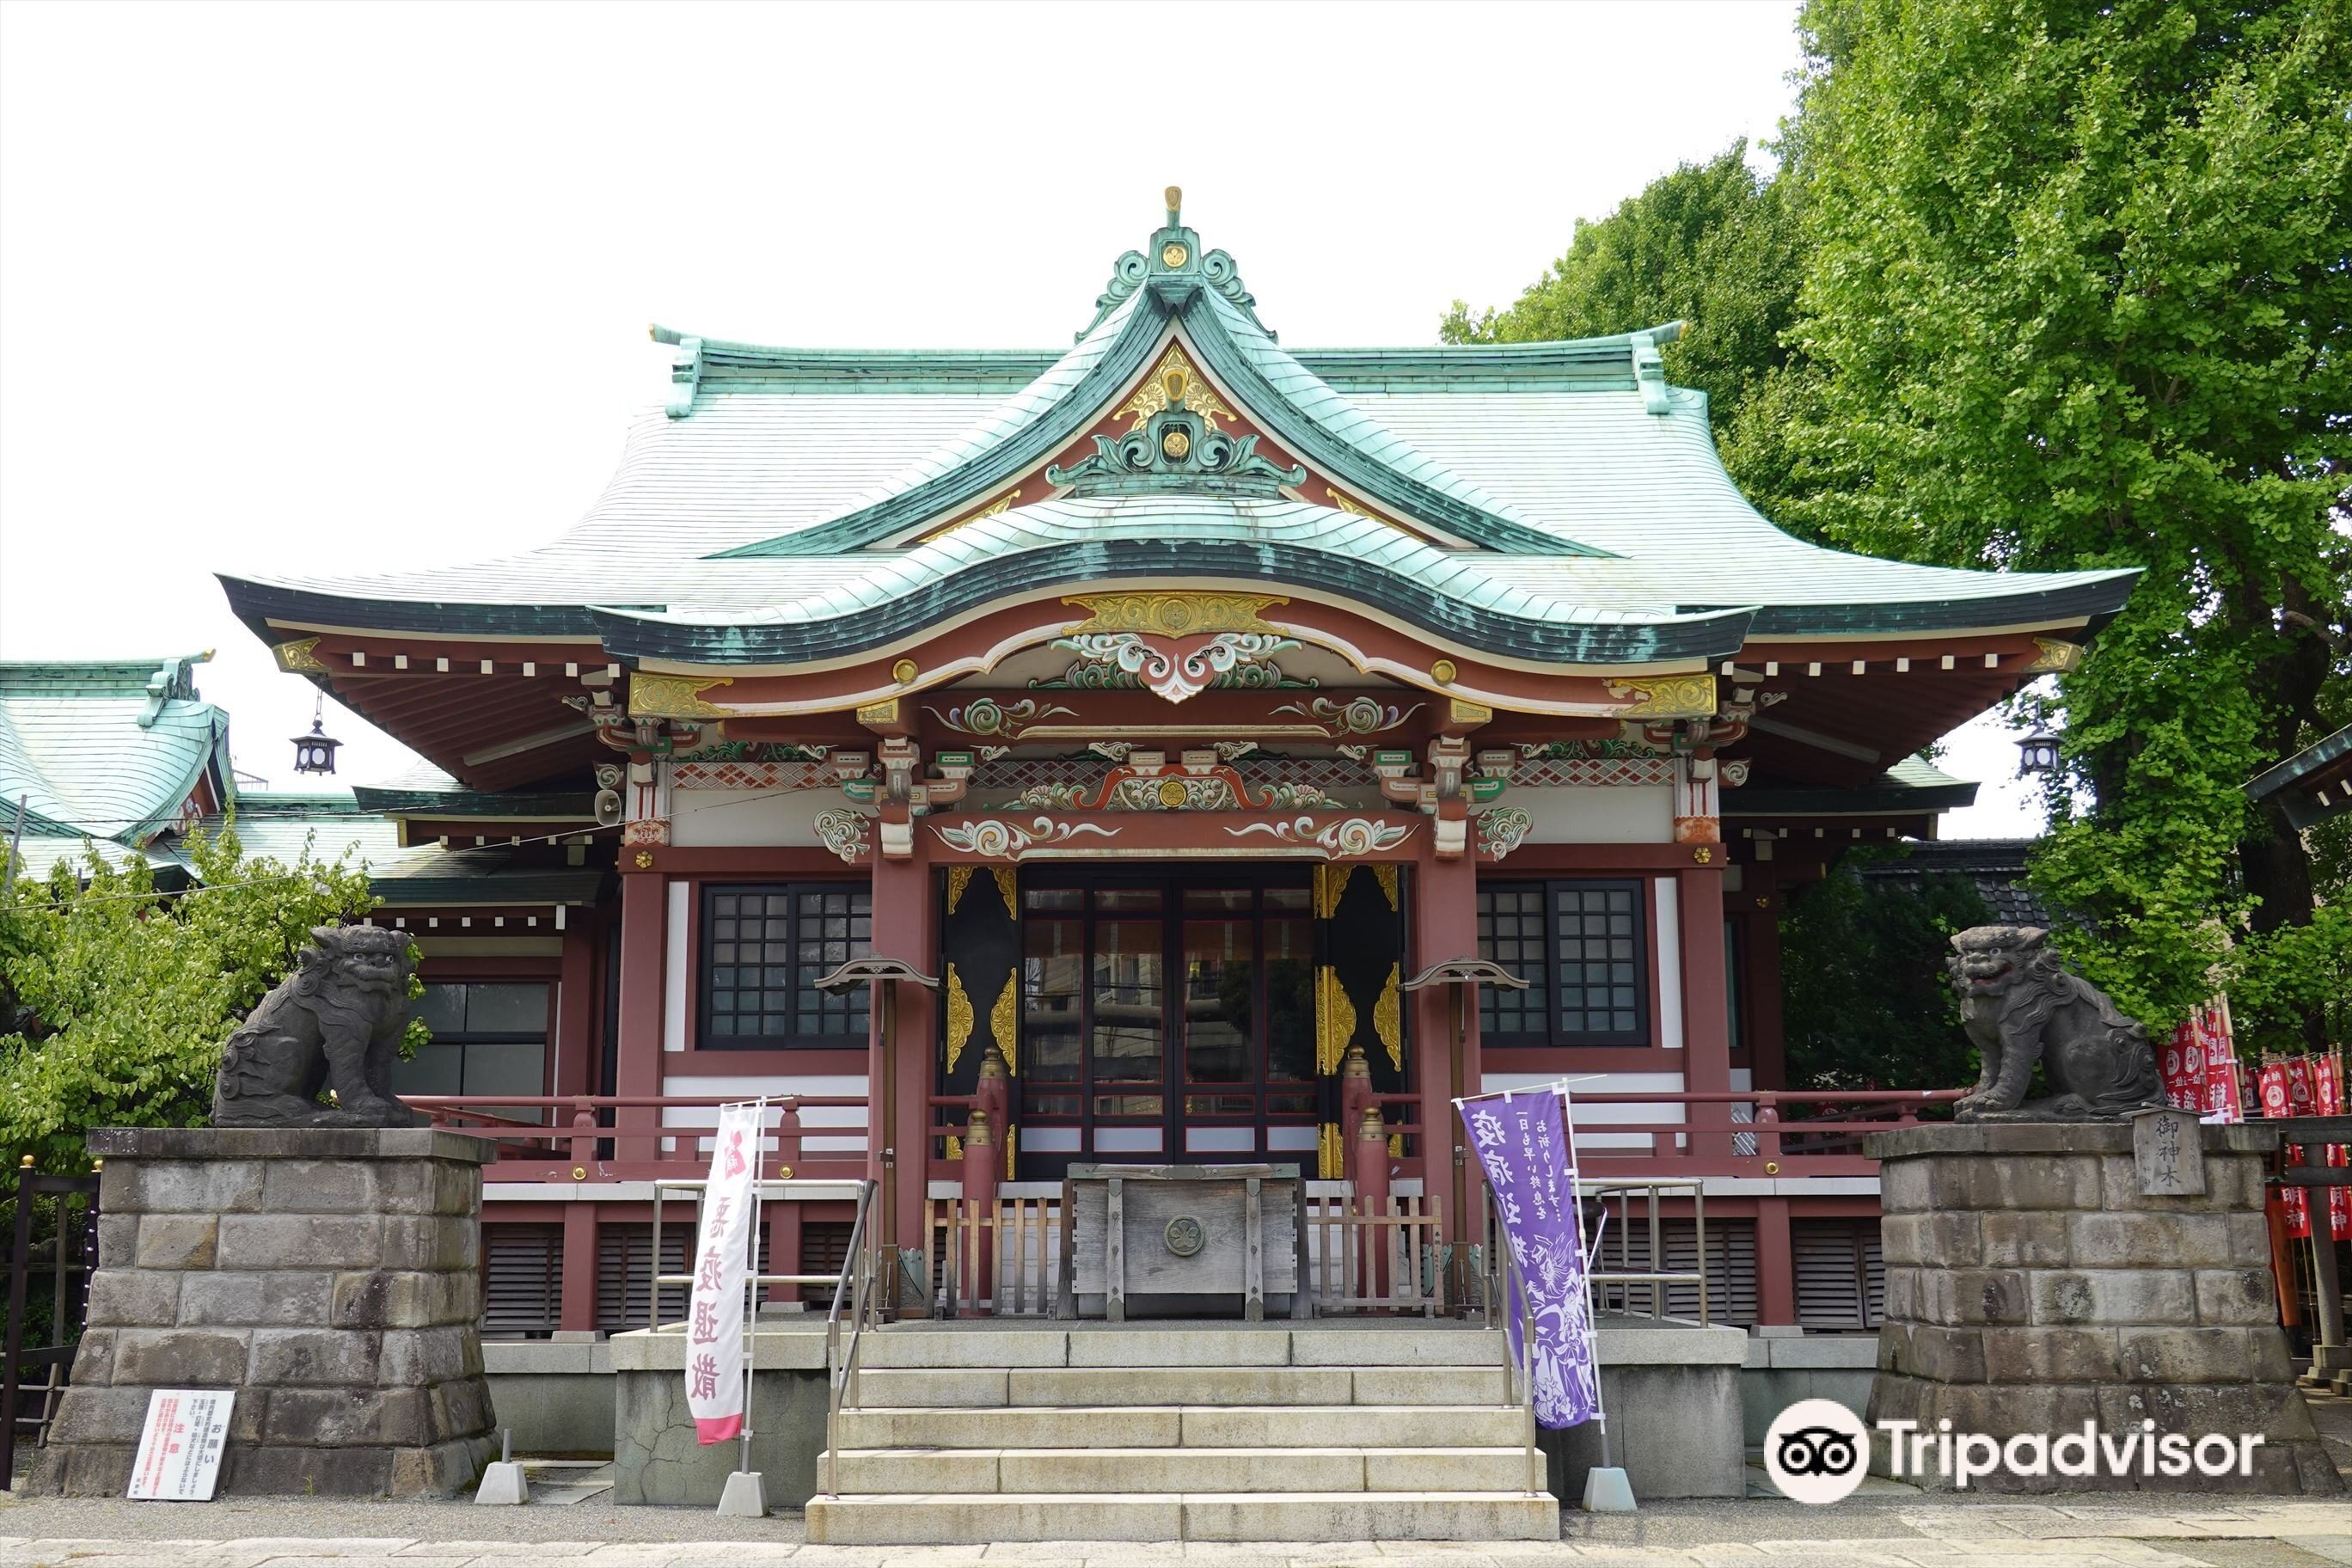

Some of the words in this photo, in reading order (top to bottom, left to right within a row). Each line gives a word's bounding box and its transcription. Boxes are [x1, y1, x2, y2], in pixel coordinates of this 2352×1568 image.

[2155, 1114, 2182, 1188] 御神木
[168, 1423, 185, 1454] 注意
[204, 1423, 223, 1464] お願い
